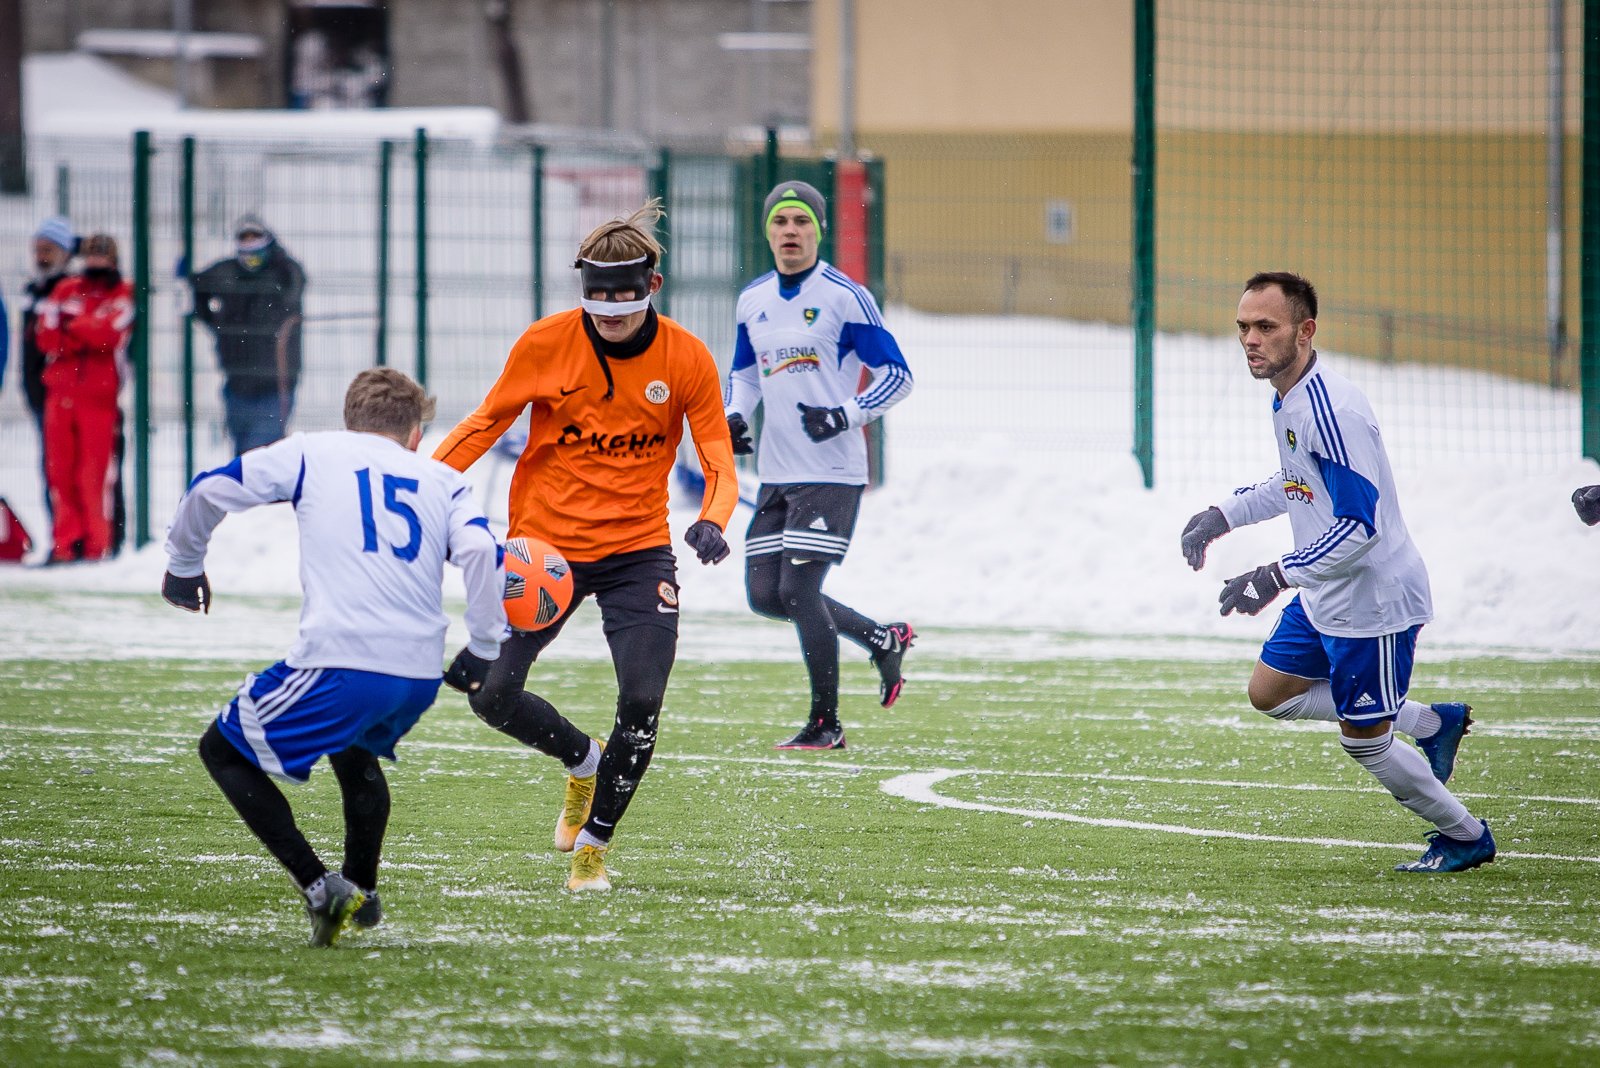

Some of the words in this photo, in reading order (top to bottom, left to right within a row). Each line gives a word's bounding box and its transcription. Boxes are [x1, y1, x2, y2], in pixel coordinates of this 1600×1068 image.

[775, 346, 818, 363] JELENIA
[591, 432, 667, 451] KGHM
[354, 467, 422, 563] 15
